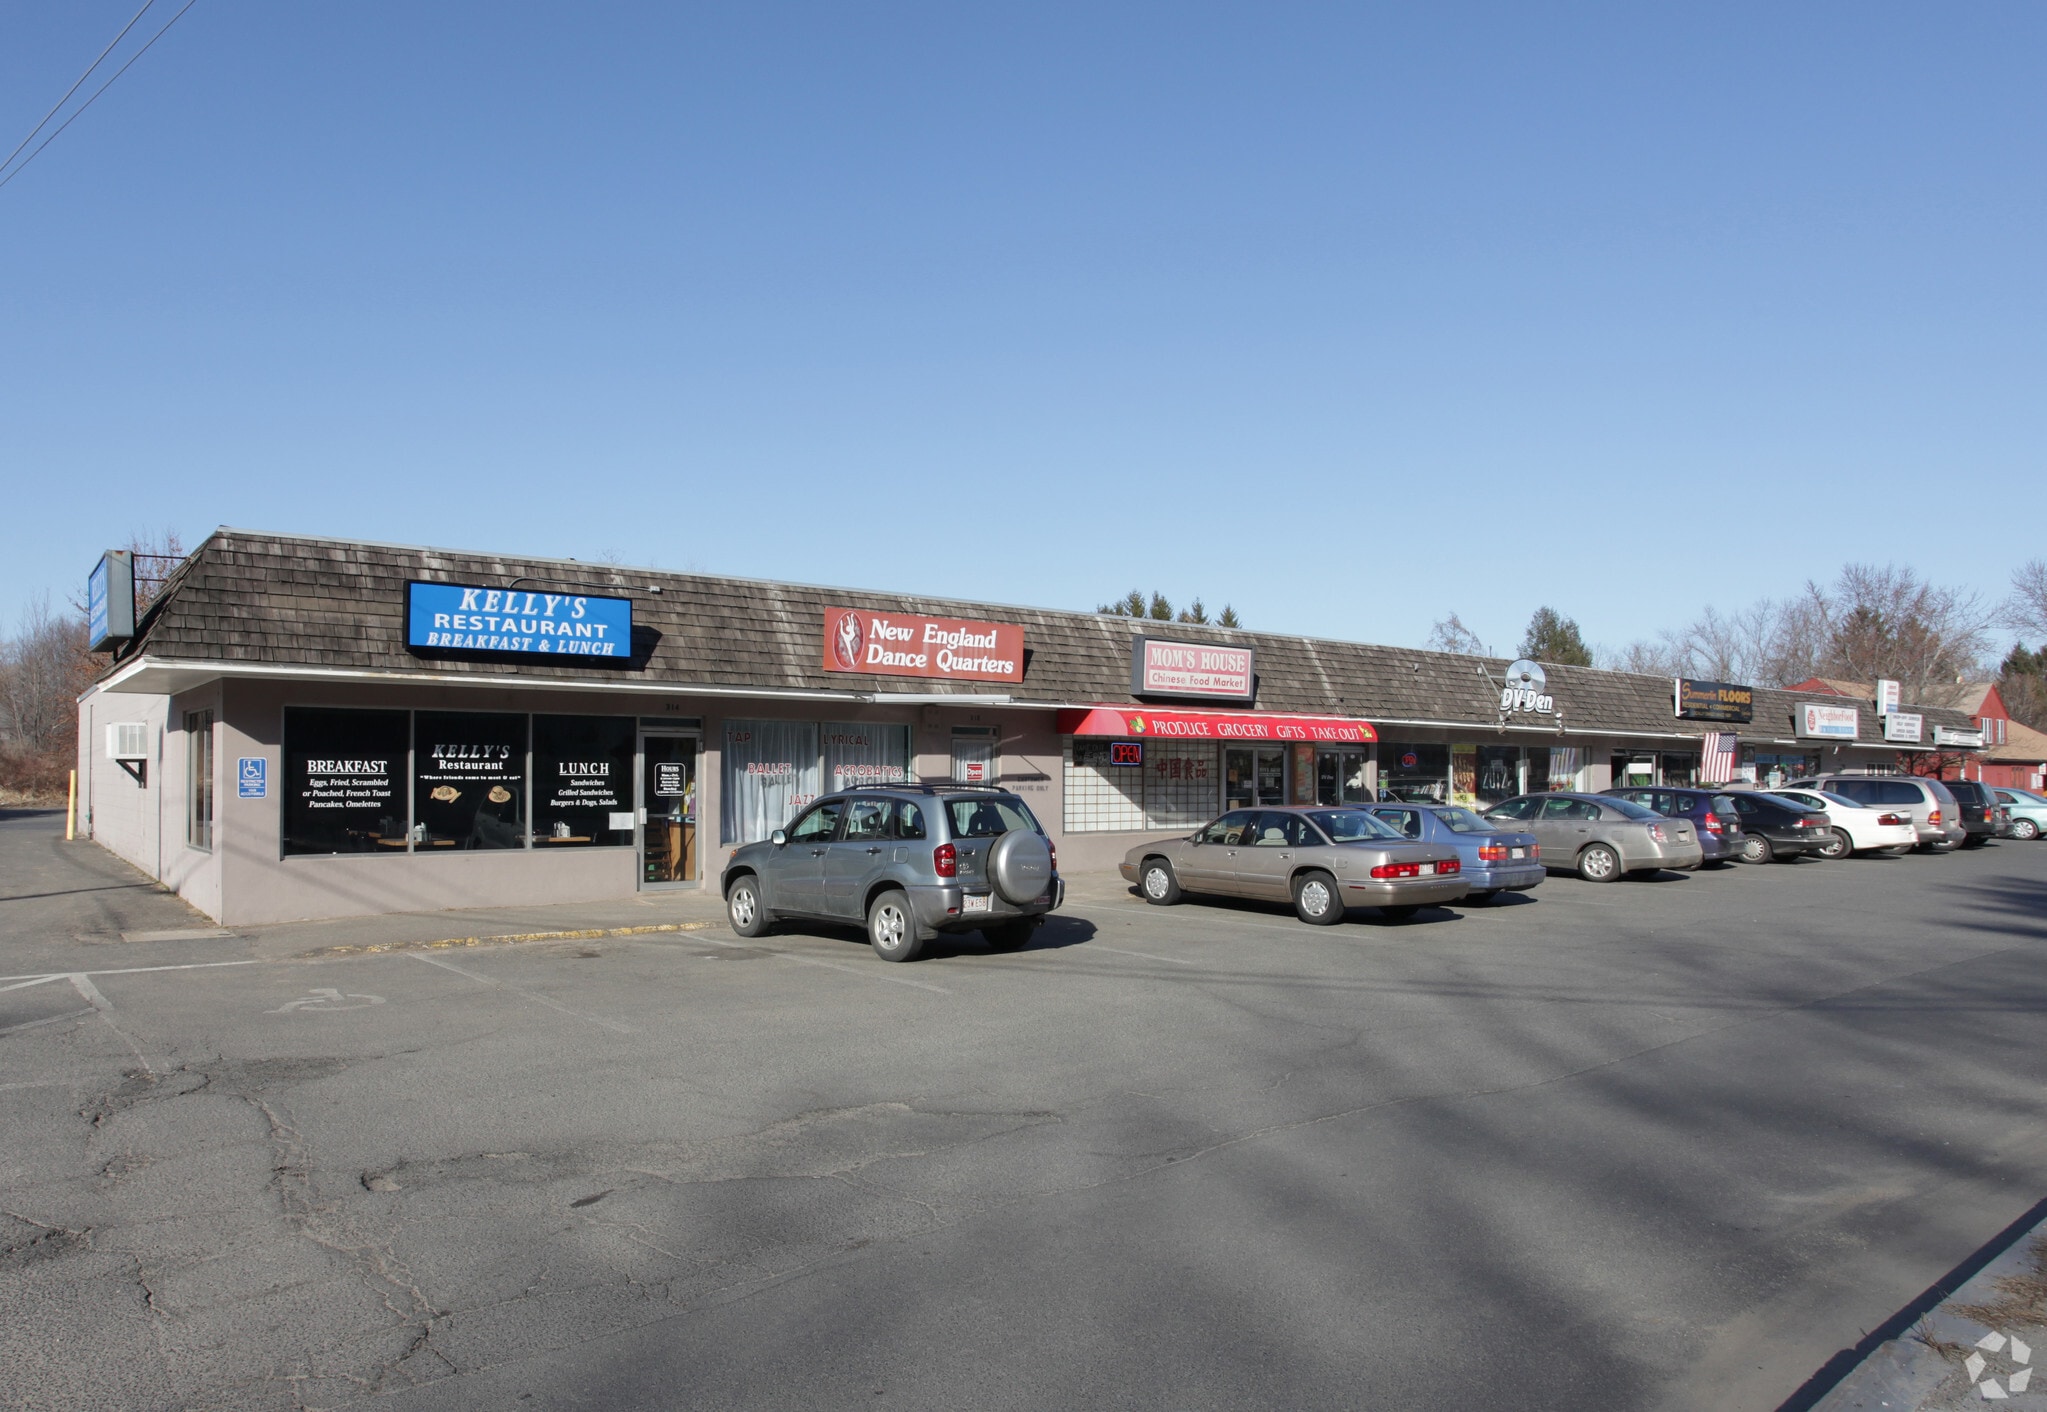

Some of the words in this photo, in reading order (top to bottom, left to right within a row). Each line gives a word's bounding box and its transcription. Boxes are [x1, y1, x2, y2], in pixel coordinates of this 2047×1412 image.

[459, 588, 588, 618] KELLY'S
[434, 613, 608, 638] RESTAURANT
[870, 618, 914, 642] New
[923, 624, 997, 650] England
[426, 632, 532, 651] BREAKFAST
[538, 639, 550, 652] &
[556, 639, 614, 656] LUNCH
[866, 644, 928, 668] Dance
[936, 649, 1014, 674] Quarters
[1150, 647, 1196, 669] MOM'S
[1200, 652, 1246, 672] HOUSE
[1152, 672, 1186, 684] Chinese
[1190, 675, 1210, 686] Food
[1213, 678, 1243, 688] Market
[1682, 682, 1716, 700] Summerlin
[1718, 689, 1752, 704] FLOORS
[728, 732, 750, 743] TAP
[1152, 720, 1211, 736] PRODUCE
[1217, 722, 1269, 738] GROCERY
[1276, 725, 1306, 739] GIFTS
[1310, 726, 1338, 740] TAKE
[1339, 728, 1360, 741] OUT
[823, 734, 869, 746] LYRICAL
[432, 744, 510, 759] KELLY'S
[1113, 745, 1140, 763] OPEN
[307, 760, 387, 774] BREAKFAST
[439, 760, 503, 770] Restaurant
[559, 762, 609, 774] LUNCH
[748, 762, 792, 775] BALLET
[834, 764, 903, 778] ACROBATICS
[967, 768, 982, 776] Open
[1156, 758, 1208, 780] 中国食品
[309, 779, 328, 788] Eggs,
[550, 799, 574, 807] Burgers
[788, 794, 815, 806] JAZZ
